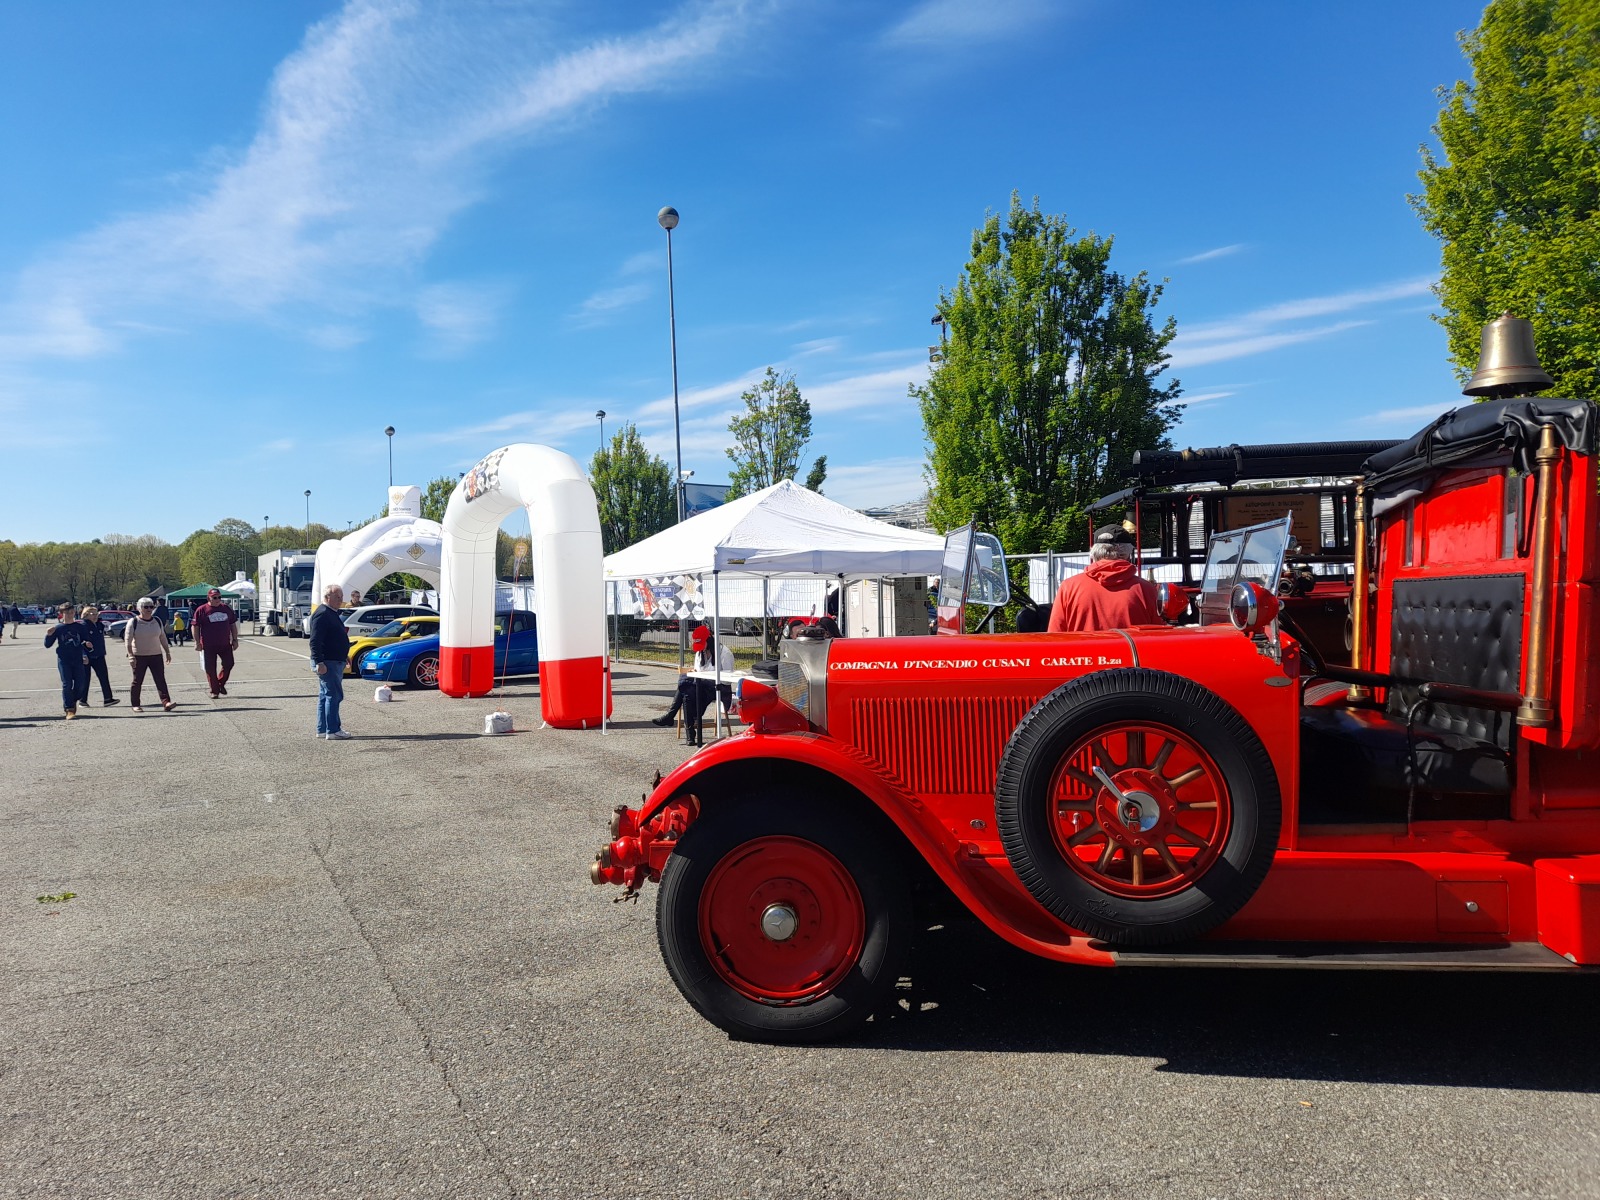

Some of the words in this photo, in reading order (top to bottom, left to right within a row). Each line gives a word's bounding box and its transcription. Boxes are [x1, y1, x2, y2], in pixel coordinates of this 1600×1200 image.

[829, 660, 899, 671] COMPAGNIA
[903, 659, 979, 669] D'INCENDIO
[982, 657, 1031, 668] CUSANI
[1040, 656, 1094, 667] CARATE
[1097, 656, 1122, 665] B.za
